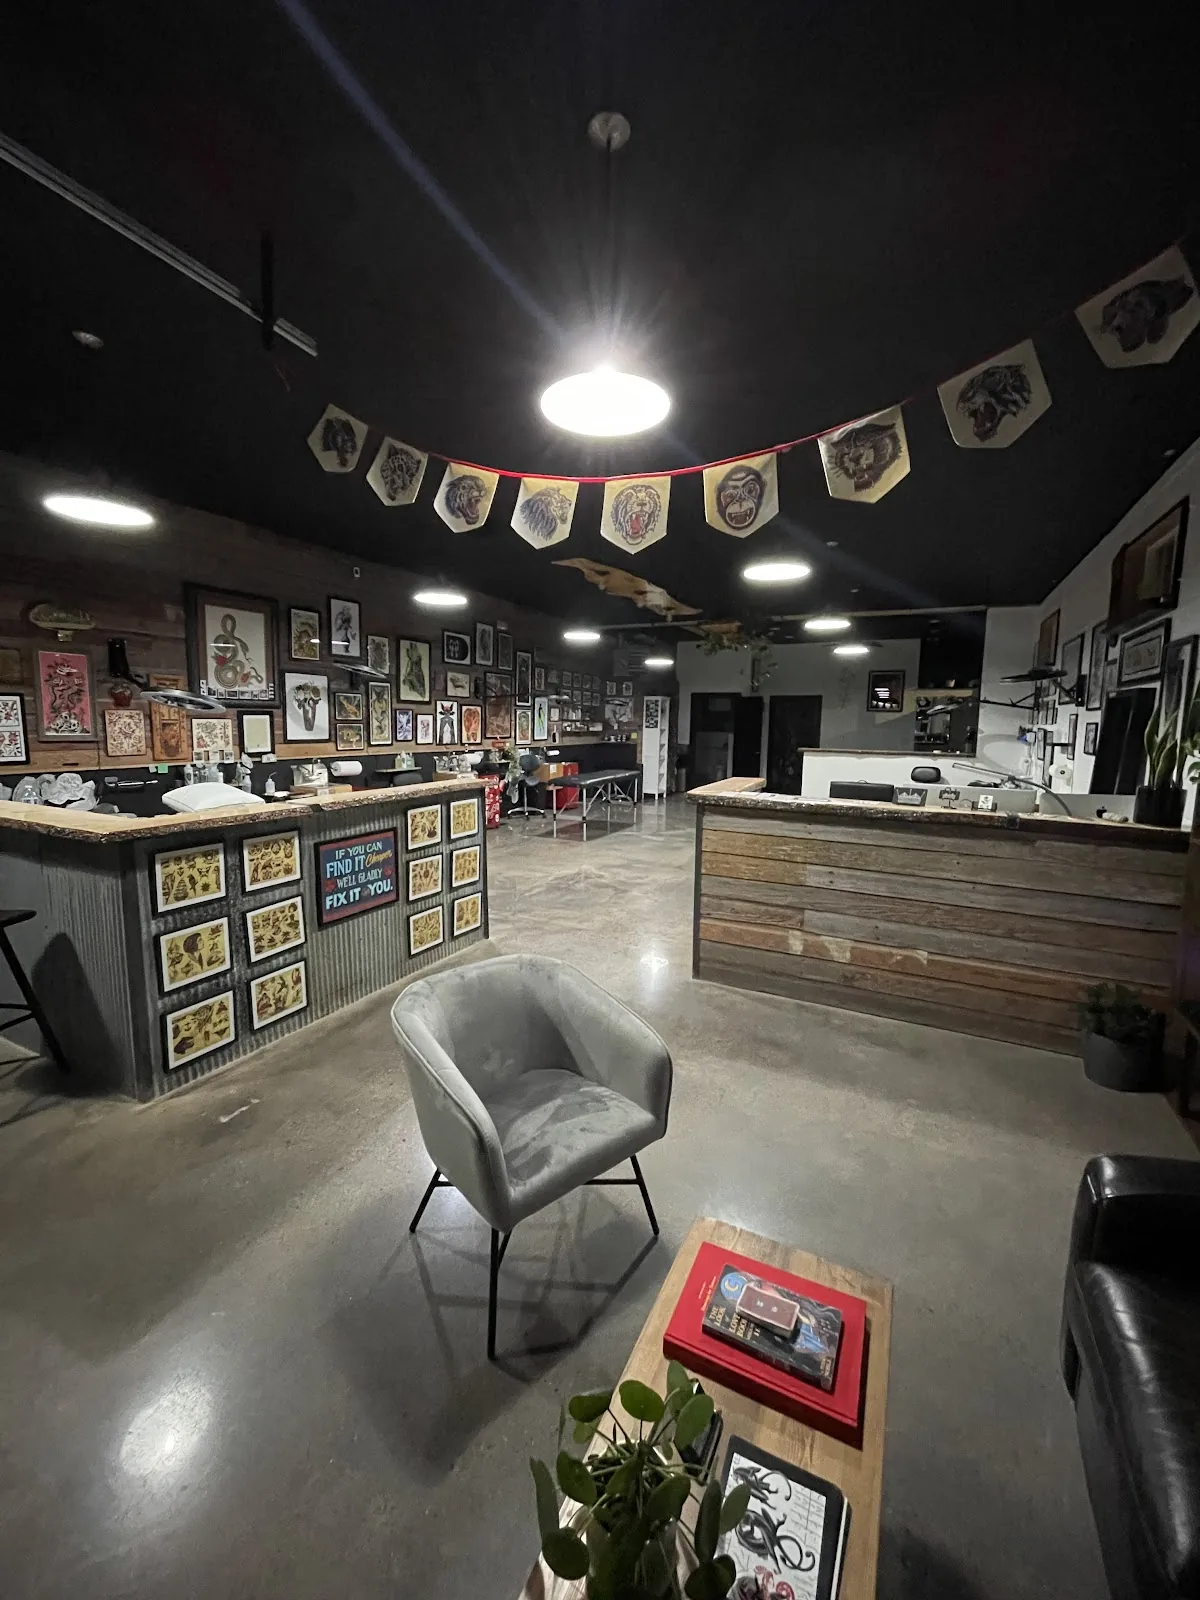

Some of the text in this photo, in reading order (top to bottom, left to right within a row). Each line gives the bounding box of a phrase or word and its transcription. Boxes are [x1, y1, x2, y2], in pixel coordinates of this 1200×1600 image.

[335, 841, 382, 860] IF YOU CAN
[326, 859, 352, 878] FIND
[354, 855, 365, 872] IT
[358, 868, 382, 884] GLADLY
[325, 891, 347, 910] FIX
[349, 887, 361, 902] IT
[367, 879, 393, 896] YOU.
[709, 1305, 719, 1320] THE
